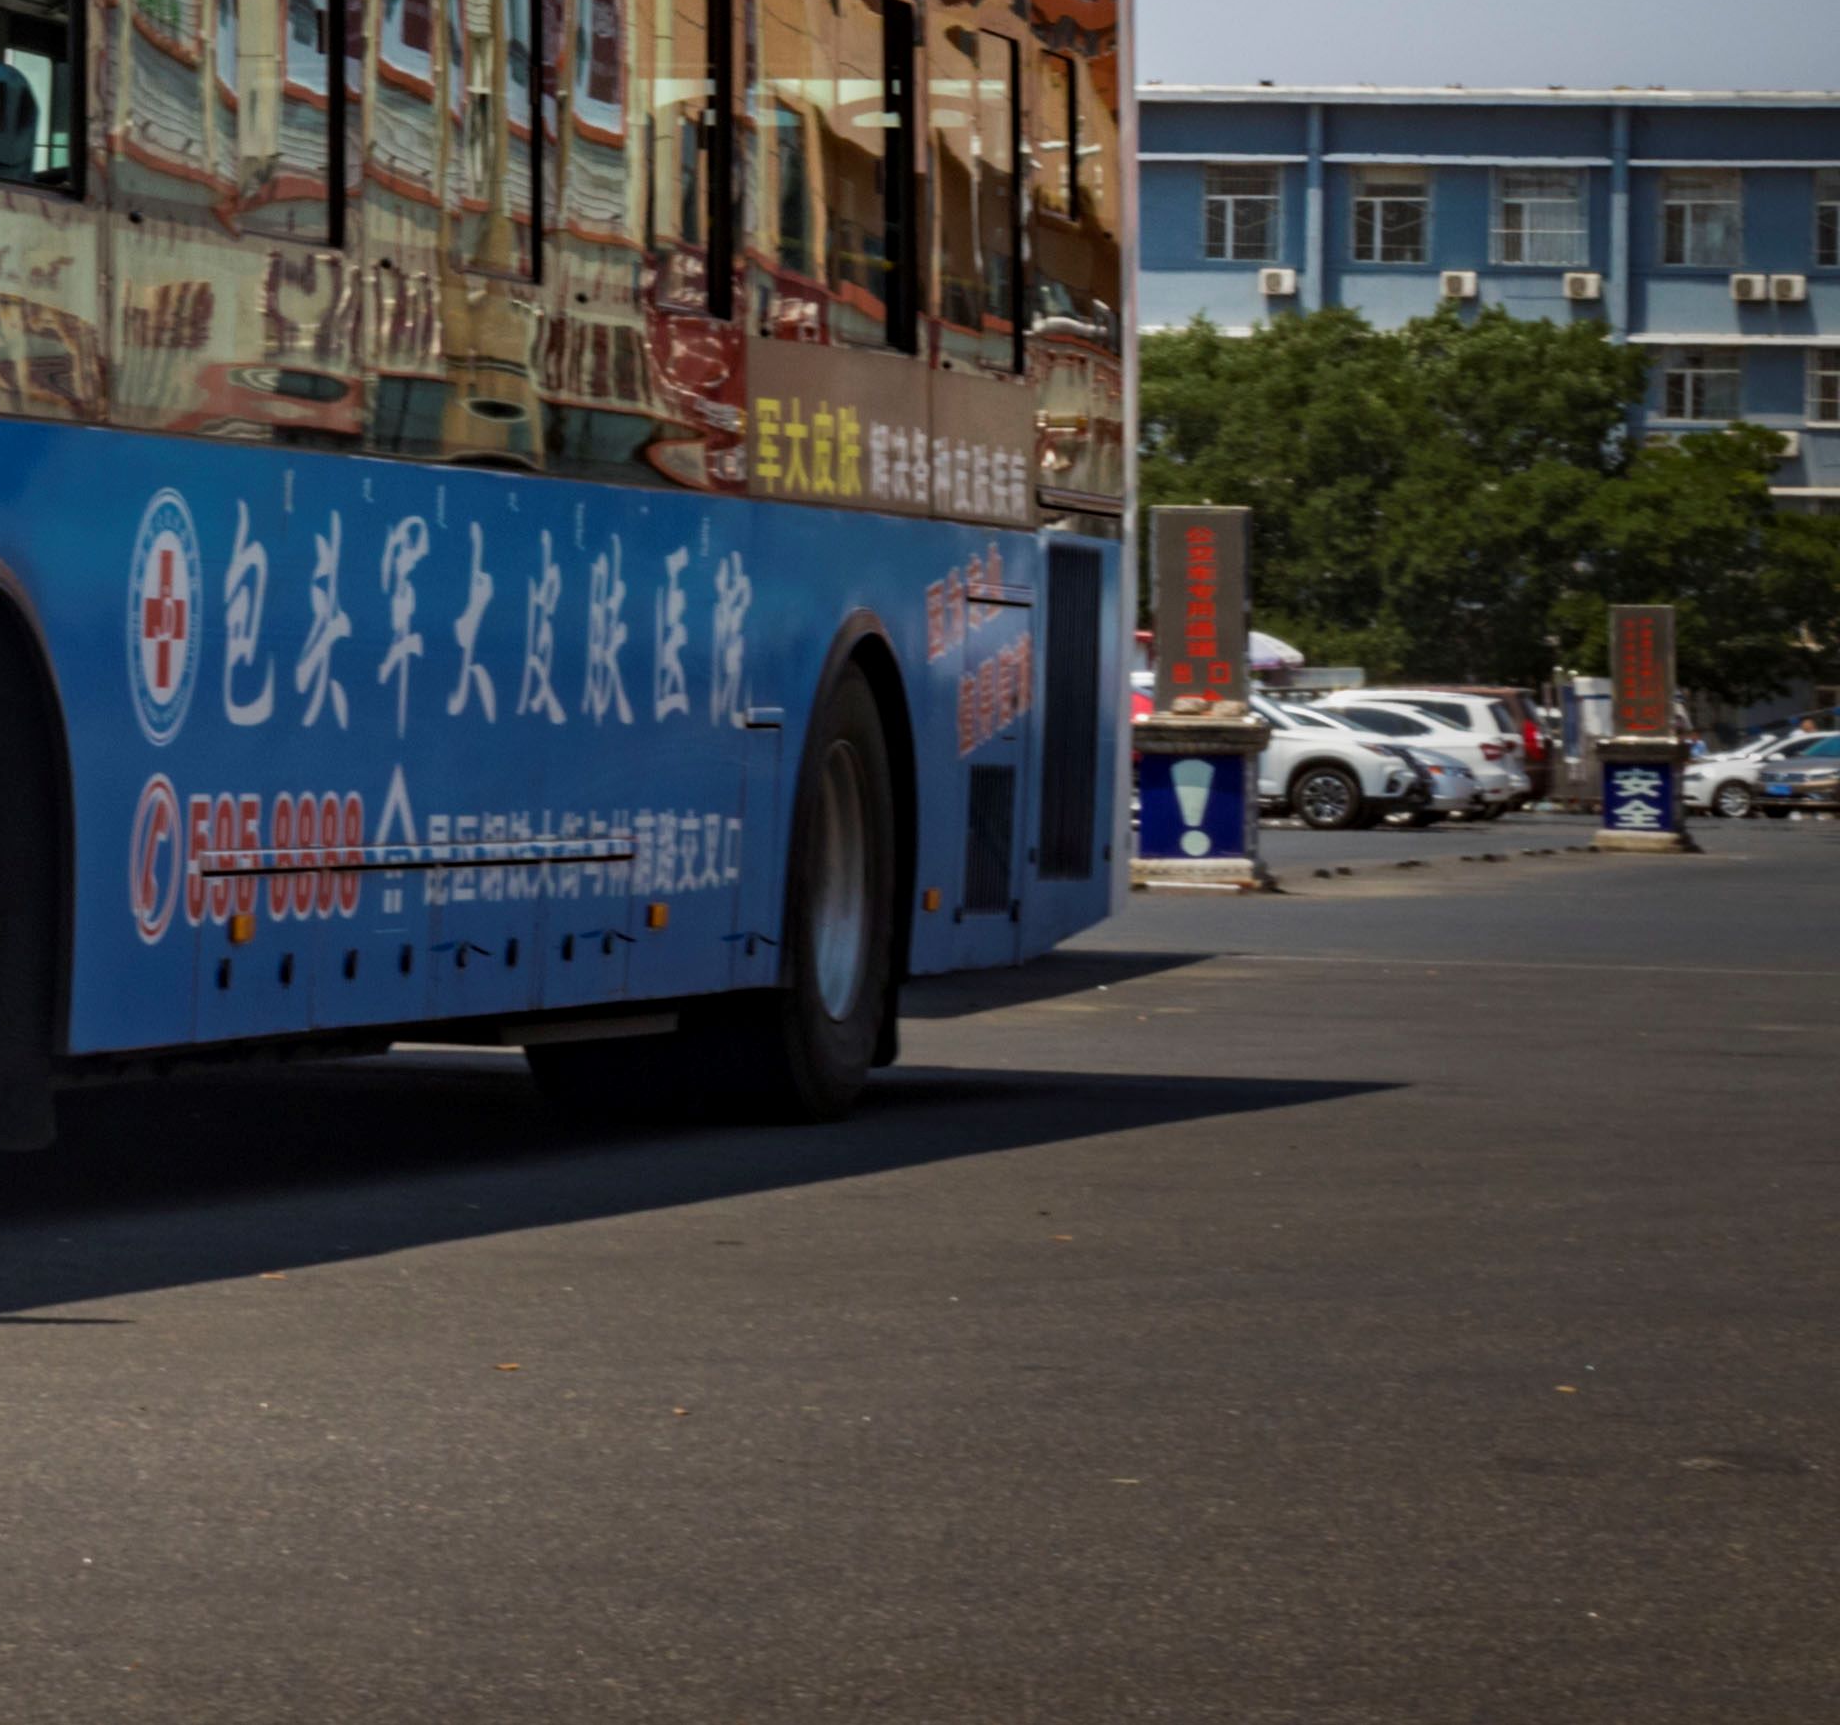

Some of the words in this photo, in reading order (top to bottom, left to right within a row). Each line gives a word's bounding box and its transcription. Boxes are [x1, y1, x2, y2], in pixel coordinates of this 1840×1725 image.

[1612, 768, 1663, 828] 安全
[183, 792, 262, 928] 595
[267, 790, 365, 922] 8888
